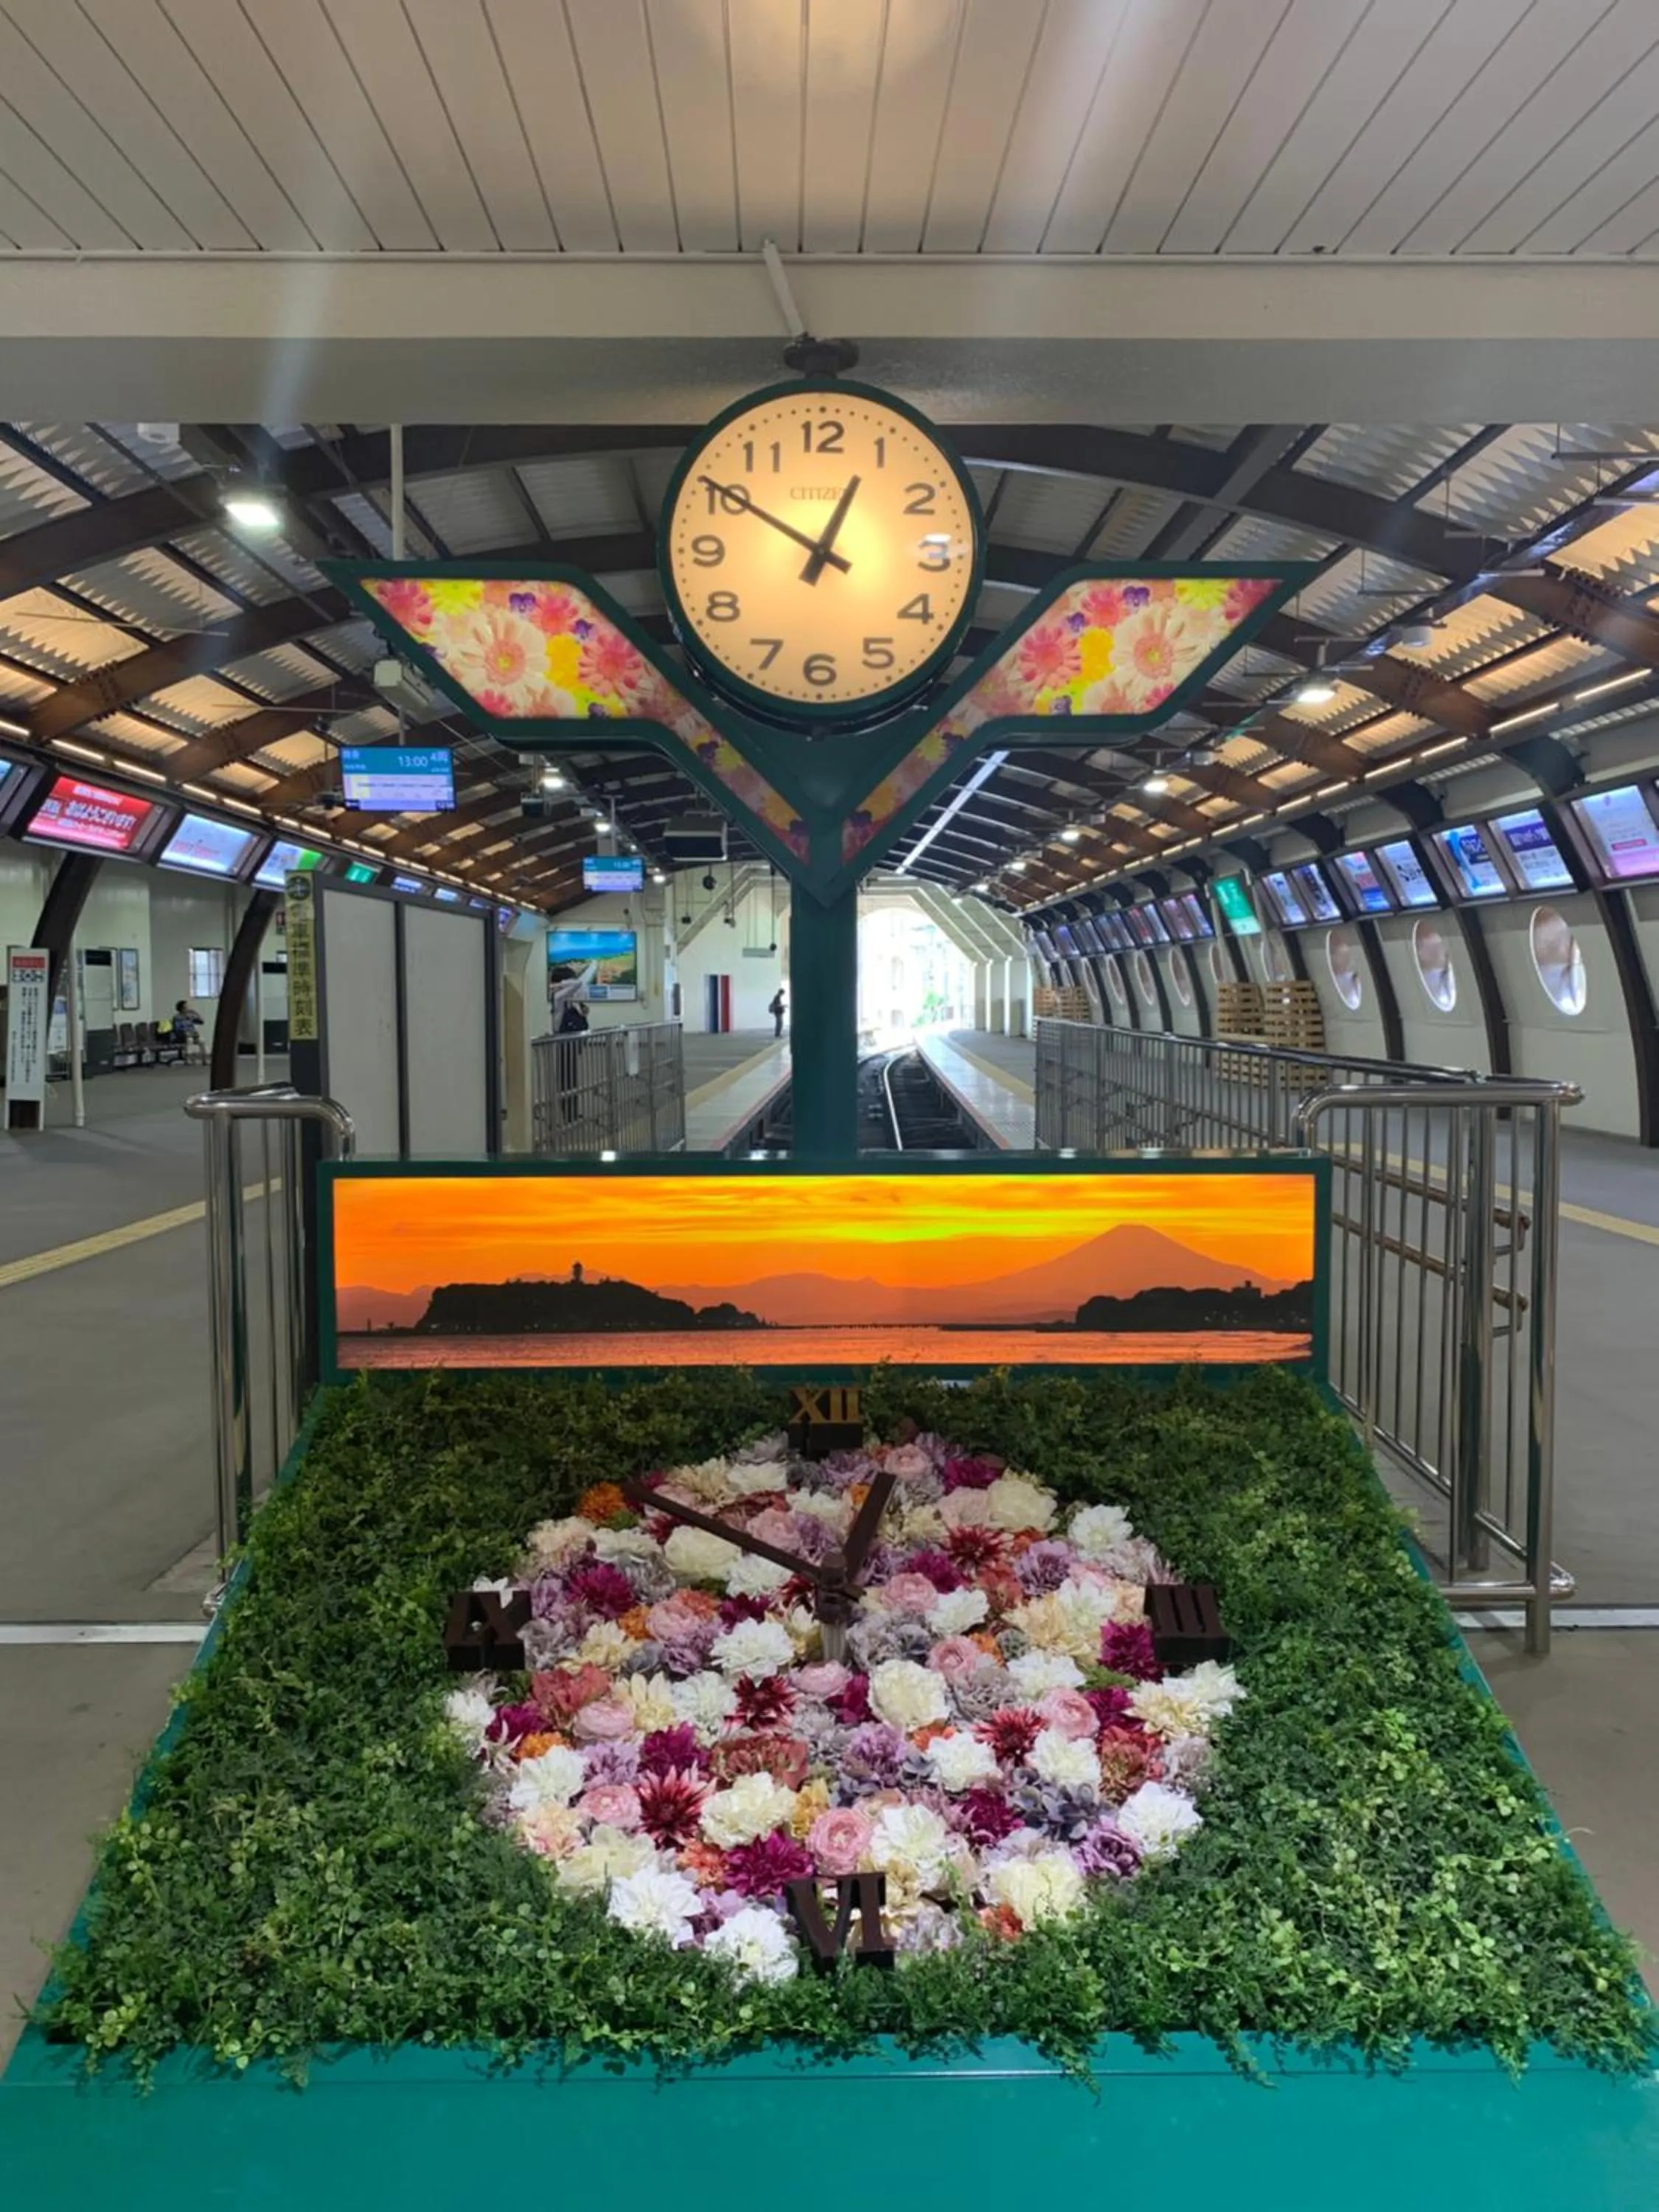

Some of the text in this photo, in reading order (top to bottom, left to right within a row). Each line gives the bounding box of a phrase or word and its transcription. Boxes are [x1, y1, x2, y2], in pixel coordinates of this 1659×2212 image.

[801, 420, 845, 453] 12
[742, 441, 780, 473] 11
[874, 437, 886, 469] 1
[705, 484, 751, 515] 10
[790, 486, 845, 501] CITIZE
[903, 482, 936, 515] 2
[691, 535, 725, 568] 9
[918, 538, 951, 572] 3
[706, 591, 740, 622] 8
[897, 593, 935, 625] 4
[749, 638, 784, 670] 7
[861, 637, 895, 669] 5
[802, 654, 837, 686] 6
[398, 756, 428, 768] 13:00
[787, 1387, 863, 1424] XII
[1147, 1584, 1229, 1638] III
[785, 1871, 897, 1960] VI
